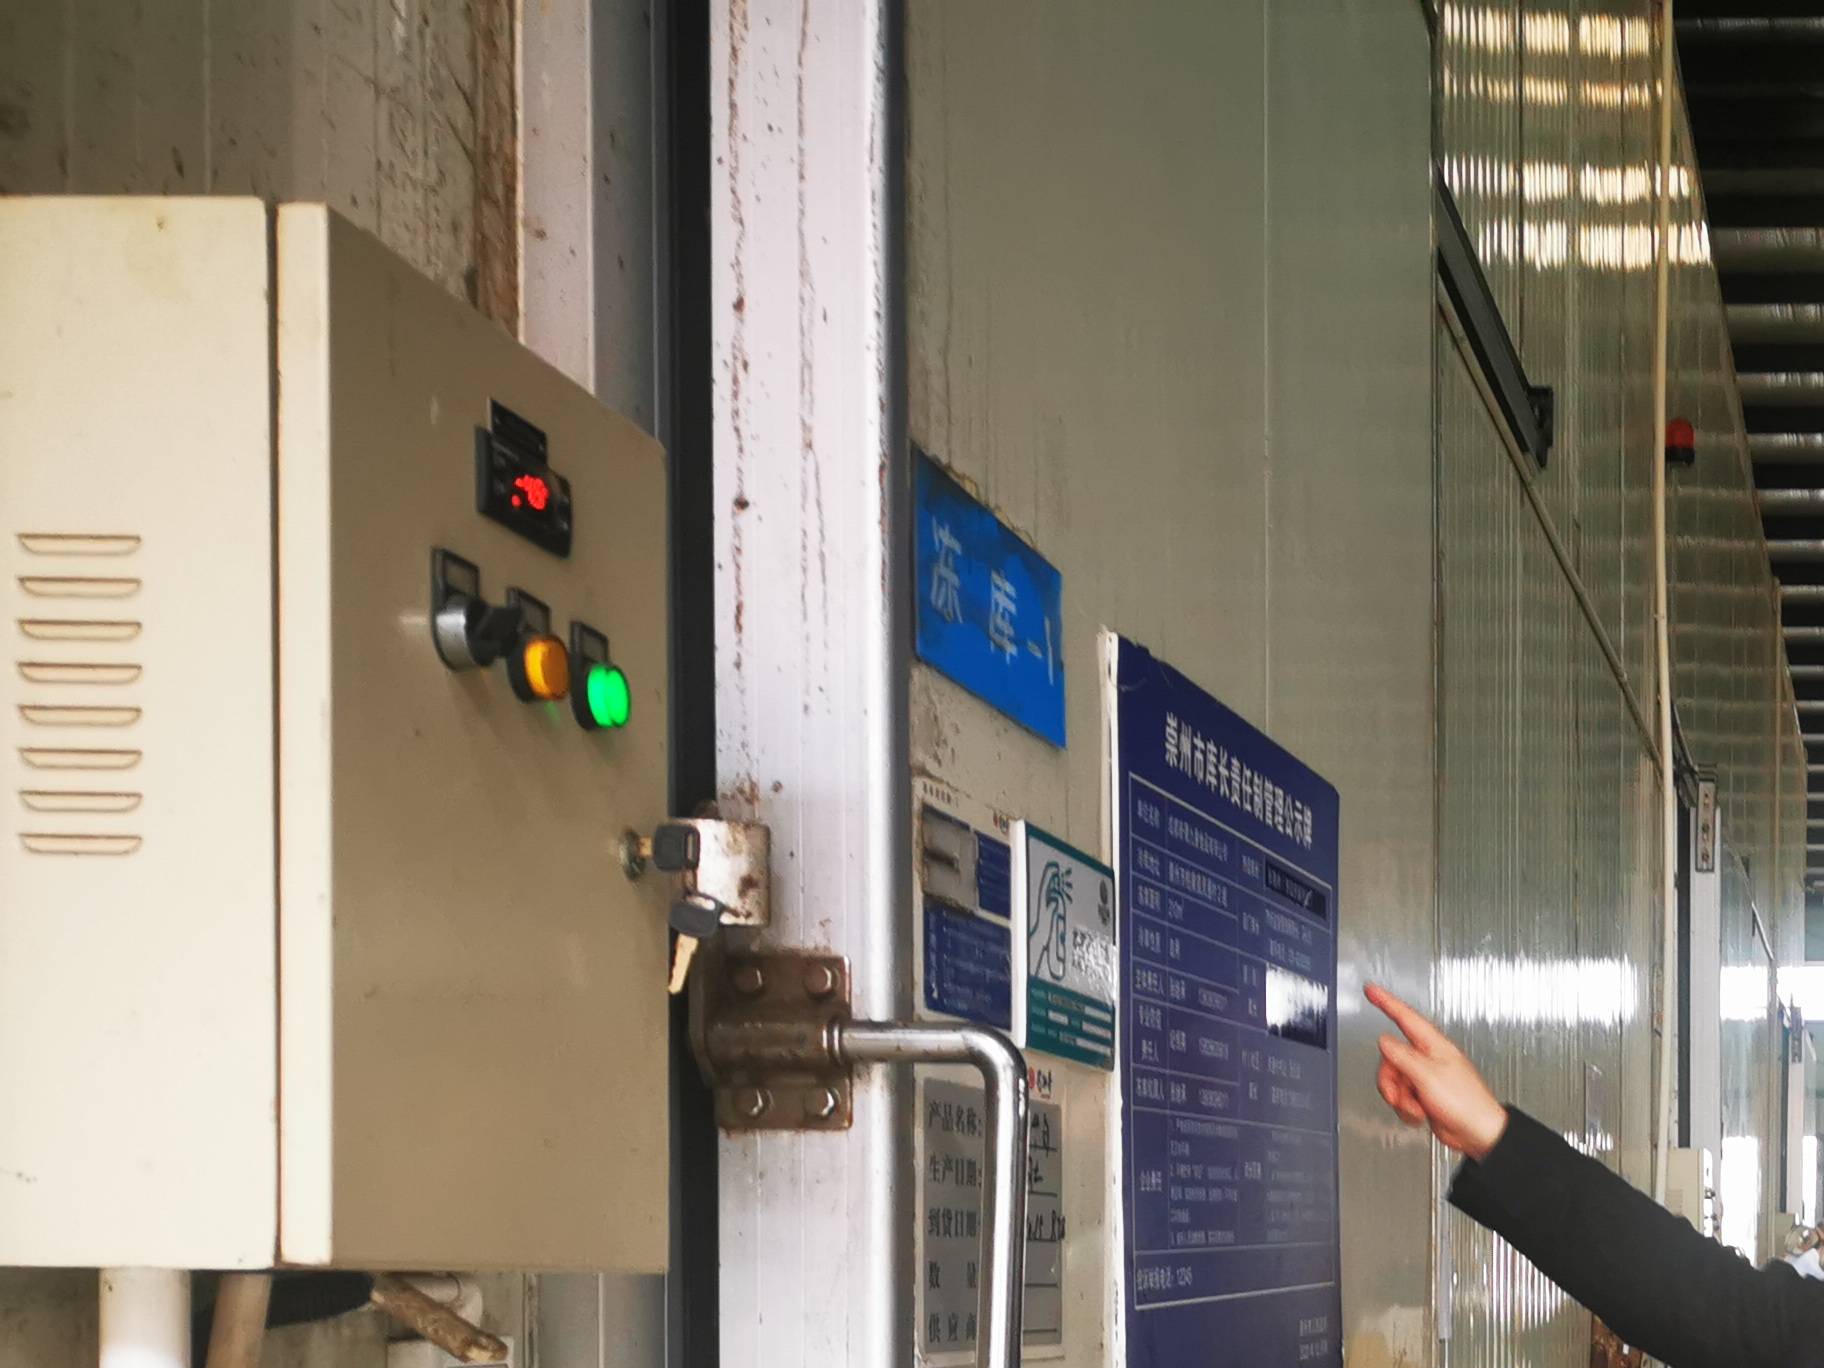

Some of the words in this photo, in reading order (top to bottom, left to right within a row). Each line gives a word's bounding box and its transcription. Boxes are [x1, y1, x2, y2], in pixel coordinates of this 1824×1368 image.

[1164, 712, 1313, 853] 崇州市库长责任制管理公示牌
